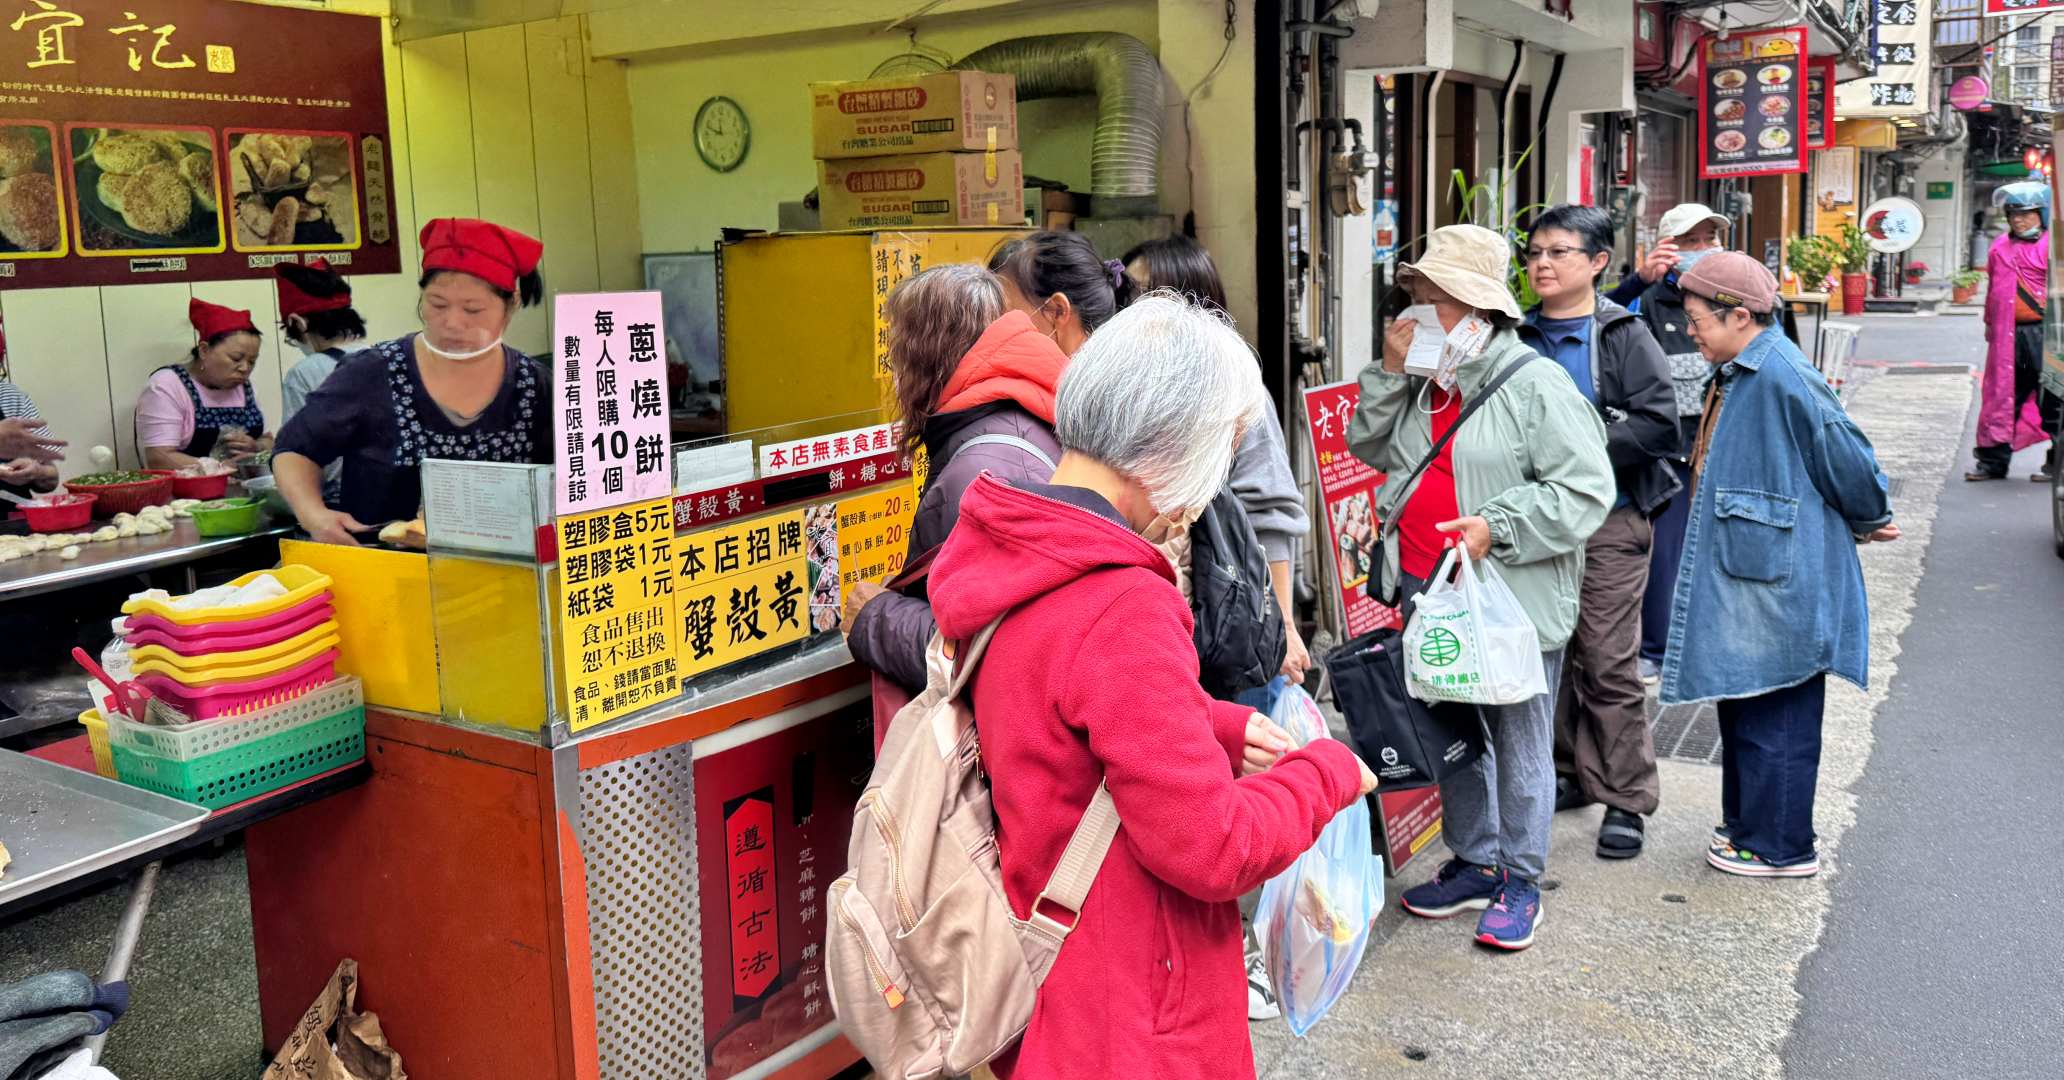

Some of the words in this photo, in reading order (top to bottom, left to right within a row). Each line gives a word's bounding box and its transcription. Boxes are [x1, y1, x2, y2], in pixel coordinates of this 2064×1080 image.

[1871, 84, 1915, 105] 炸物
[856, 124, 911, 135] SUGAR
[863, 204, 911, 214] SUGAR
[564, 335, 587, 504] 數量有限請見諒
[592, 310, 629, 495] 每人限購10個
[628, 323, 664, 476] 蔥燒餅
[885, 496, 900, 517] 20
[904, 500, 910, 512] 元
[679, 520, 801, 581] 本店招牌
[886, 524, 901, 545] 20
[888, 552, 903, 573] 20
[568, 582, 614, 618] 紙袋
[640, 570, 673, 598] 1元
[582, 606, 664, 647] 食品售出
[684, 570, 803, 660] 蟹殼黃
[582, 632, 665, 673] 恕不退換
[734, 824, 774, 981] 遵循古法
